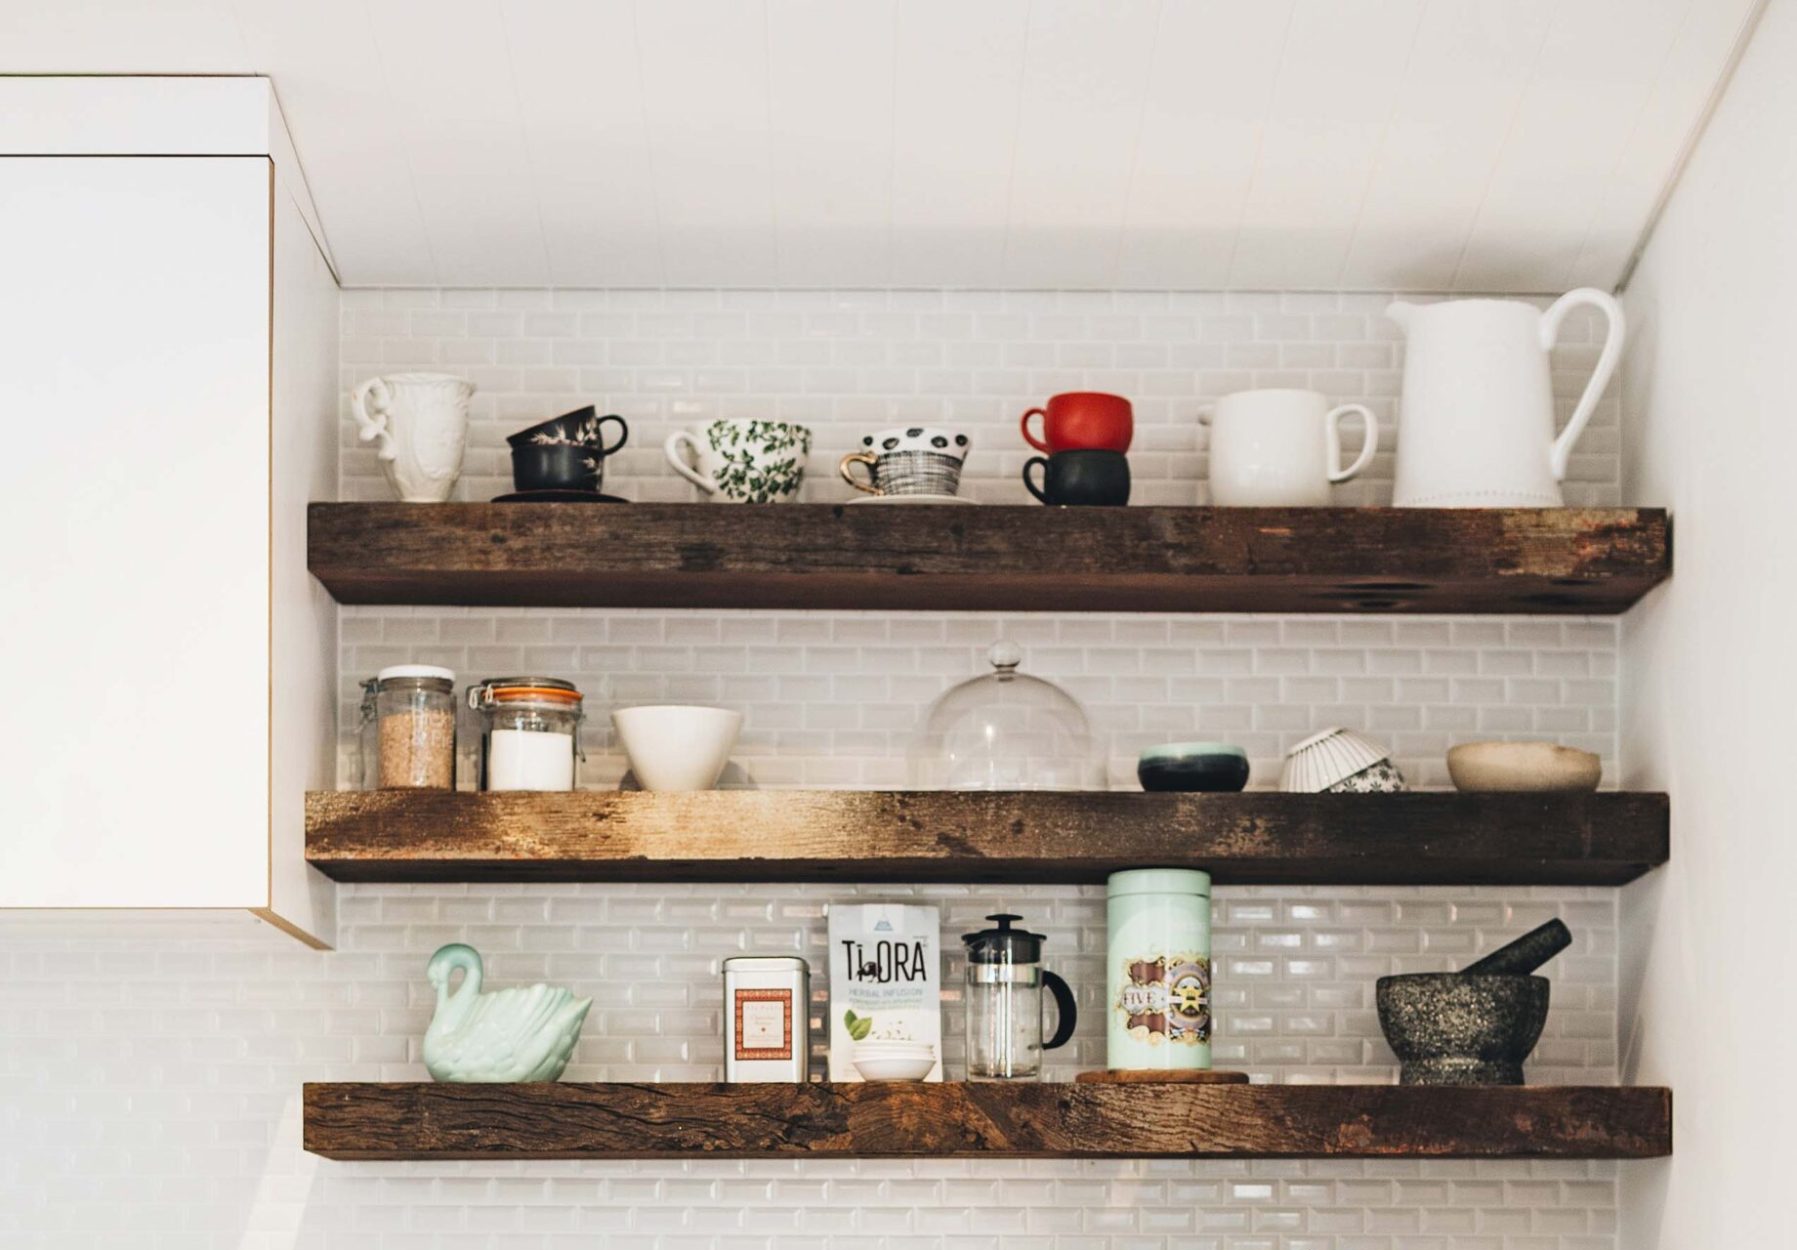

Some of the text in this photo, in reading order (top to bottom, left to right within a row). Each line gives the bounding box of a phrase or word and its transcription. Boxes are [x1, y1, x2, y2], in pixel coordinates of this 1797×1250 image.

[877, 940, 927, 983] ORA
[883, 988, 923, 998] INFUSION
[1123, 991, 1156, 1006] FIVE
